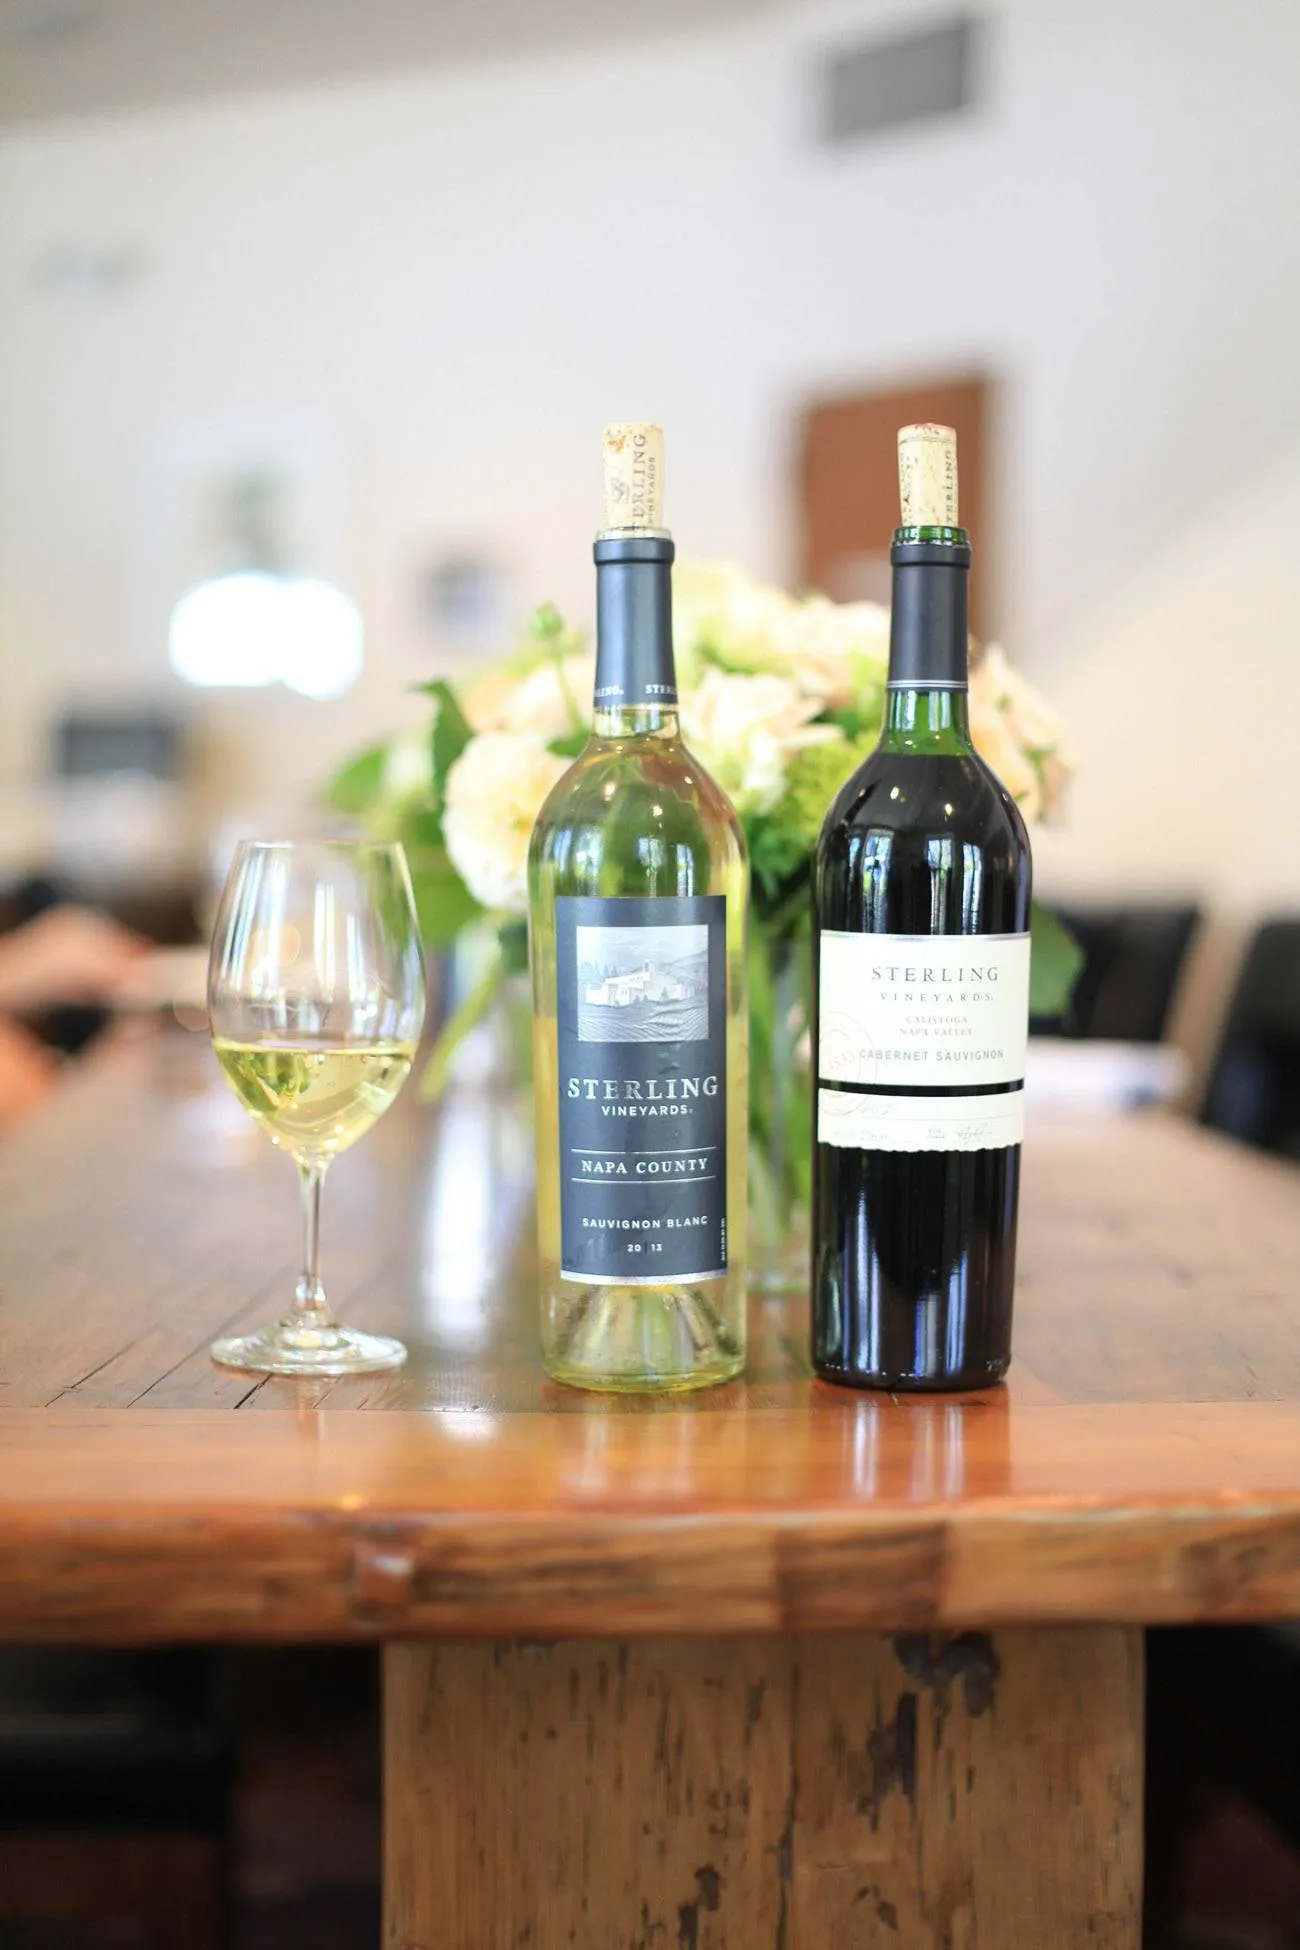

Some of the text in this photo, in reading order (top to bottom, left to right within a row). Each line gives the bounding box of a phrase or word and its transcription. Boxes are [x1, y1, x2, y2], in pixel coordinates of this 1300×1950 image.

[871, 966, 999, 983] STERLING
[905, 1015, 968, 1024] CALISTOGA
[900, 1028, 974, 1037] NAPA VALLEY
[859, 1048, 929, 1062] CABERNET
[935, 1049, 1005, 1061] SAUVIGNON
[567, 1075, 719, 1100] STERLING
[601, 1104, 690, 1117] VINEYARDS
[581, 1158, 708, 1174] NAPA COUNTY
[582, 1216, 708, 1230] SAUVIGNON BLANC
[627, 1243, 662, 1253] 20 13
